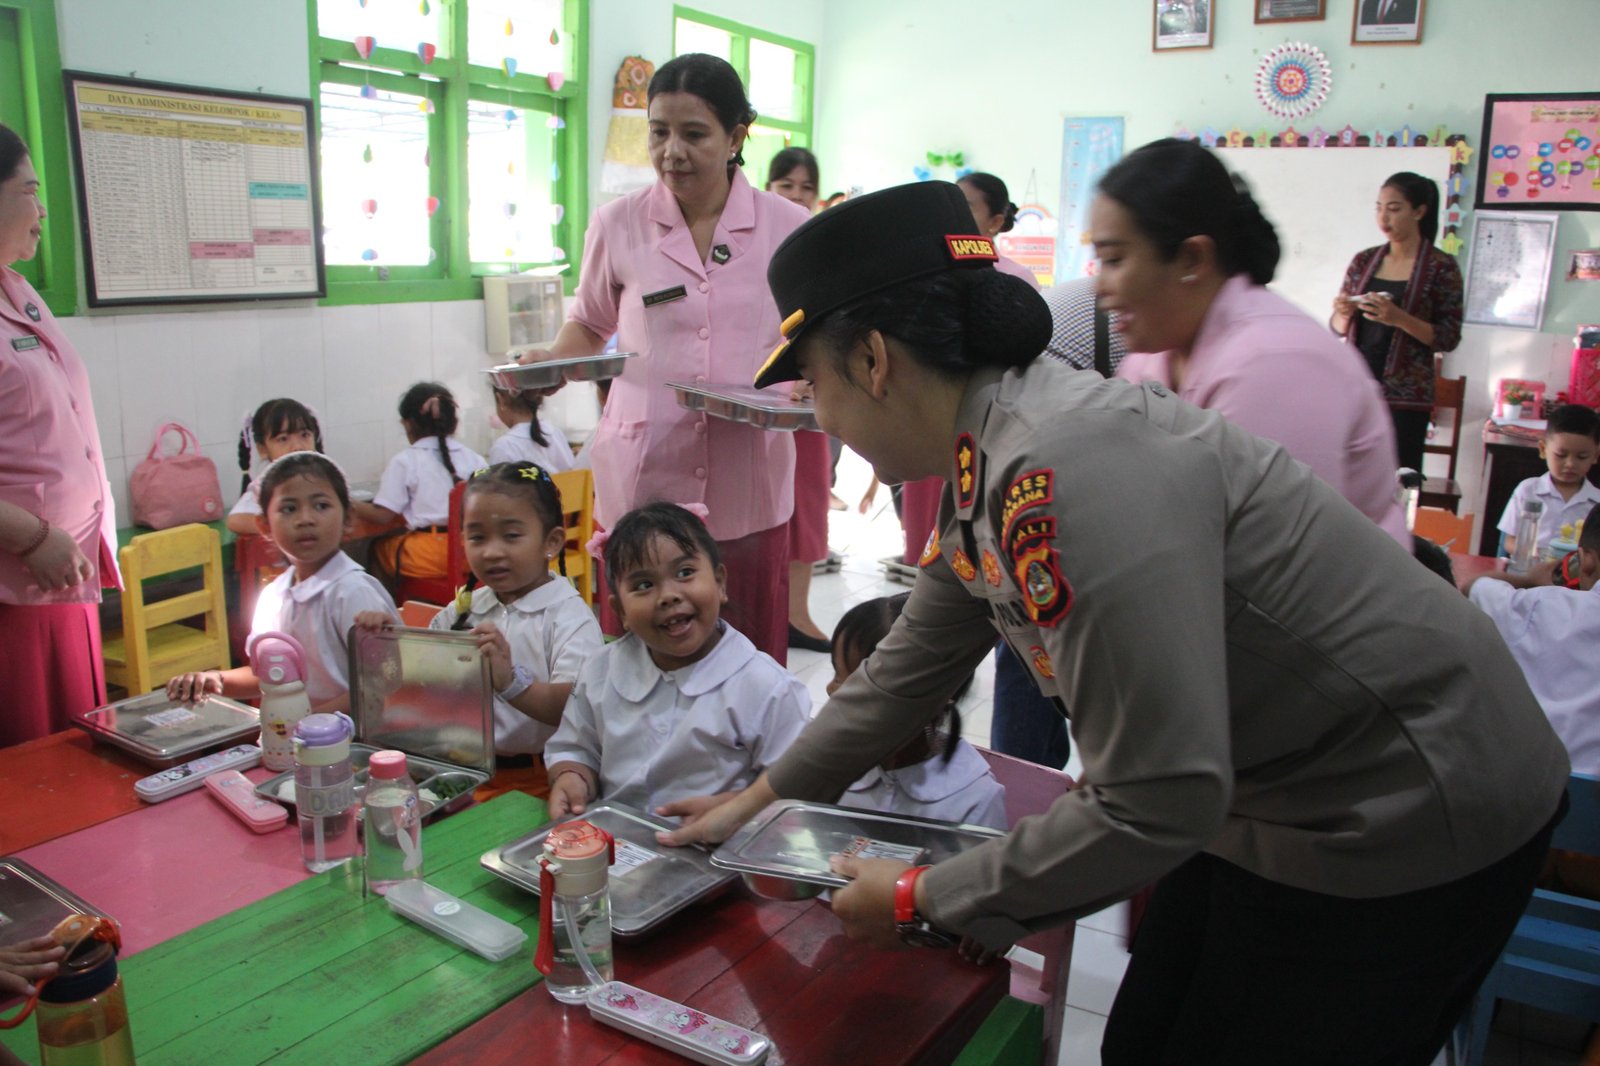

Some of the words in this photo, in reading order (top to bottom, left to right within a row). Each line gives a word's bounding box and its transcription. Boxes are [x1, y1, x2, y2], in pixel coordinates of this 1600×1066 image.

[108, 93, 134, 105] DATA
[136, 97, 201, 111] ADMINISTRASI
[203, 103, 250, 116] KELOMPOK
[255, 109, 282, 120] KELAS
[1014, 522, 1047, 545] ALI
